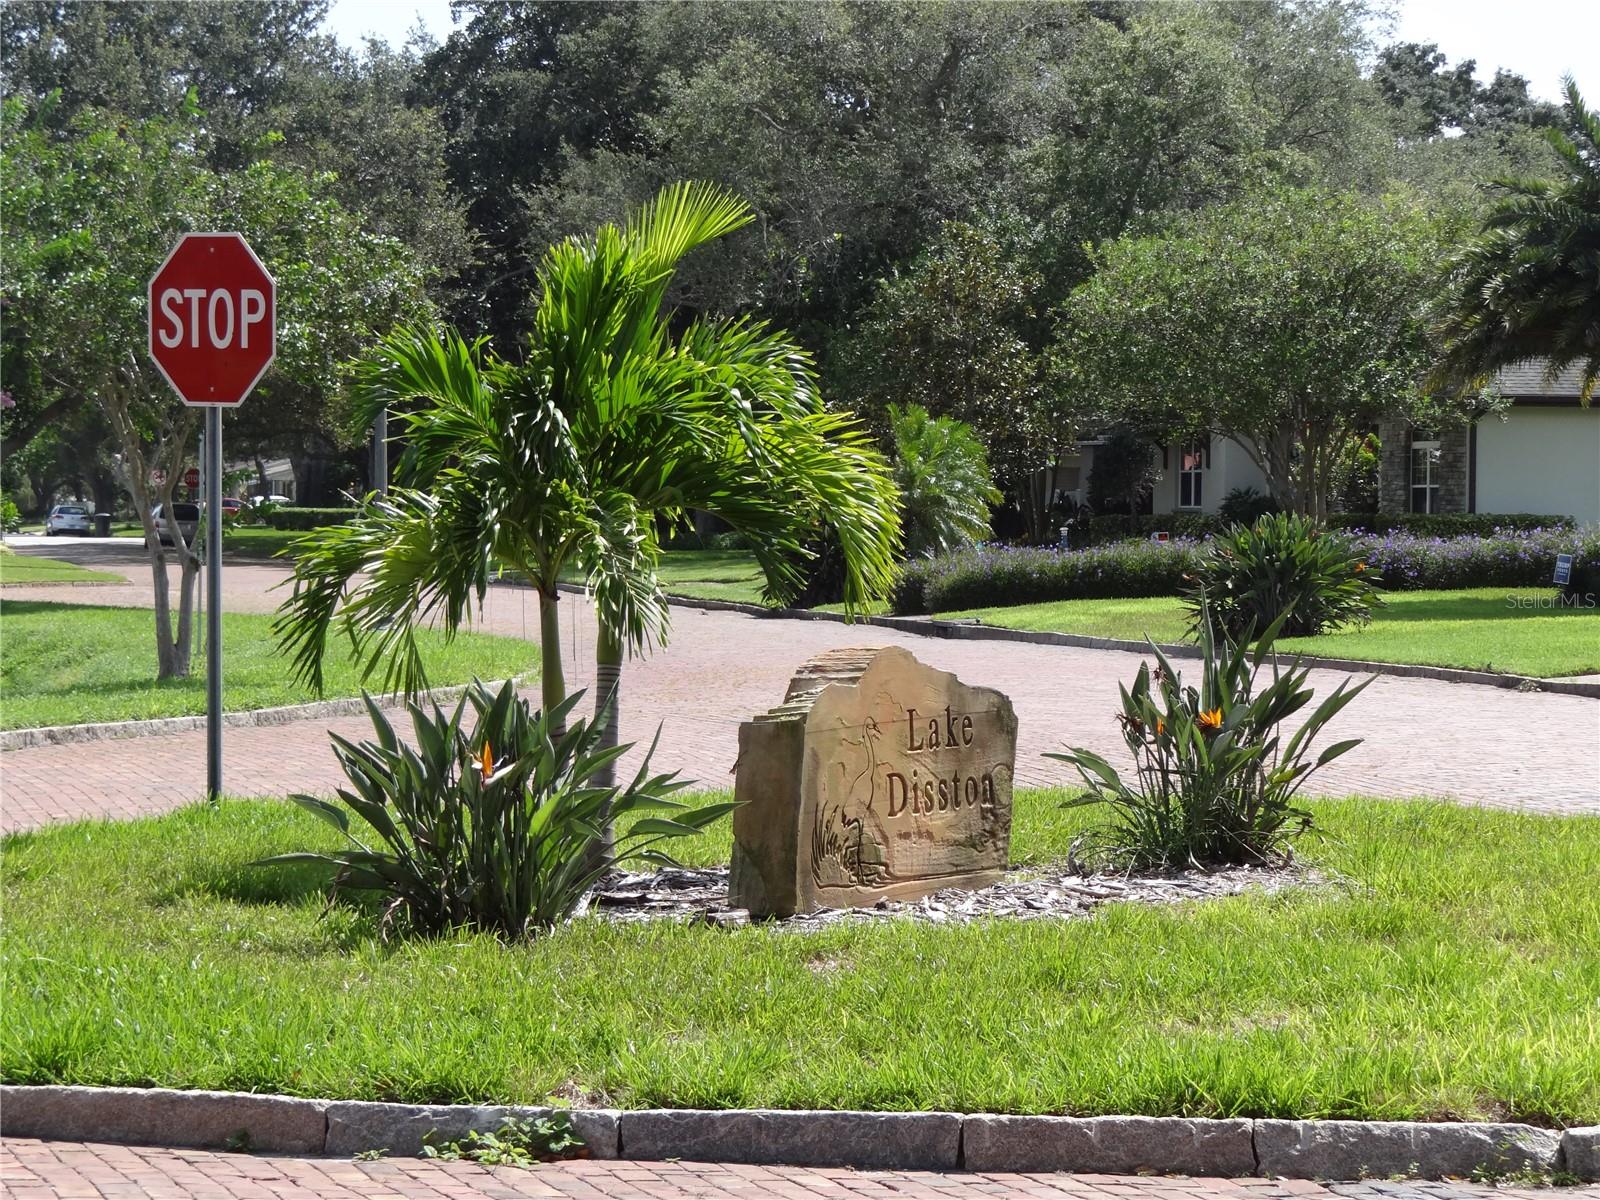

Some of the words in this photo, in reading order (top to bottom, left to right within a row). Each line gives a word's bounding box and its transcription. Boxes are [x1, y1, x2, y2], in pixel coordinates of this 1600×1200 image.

[158, 287, 266, 349] STOP
[185, 474, 199, 483] STO
[906, 704, 974, 753] Lake
[886, 768, 996, 818] Disston
